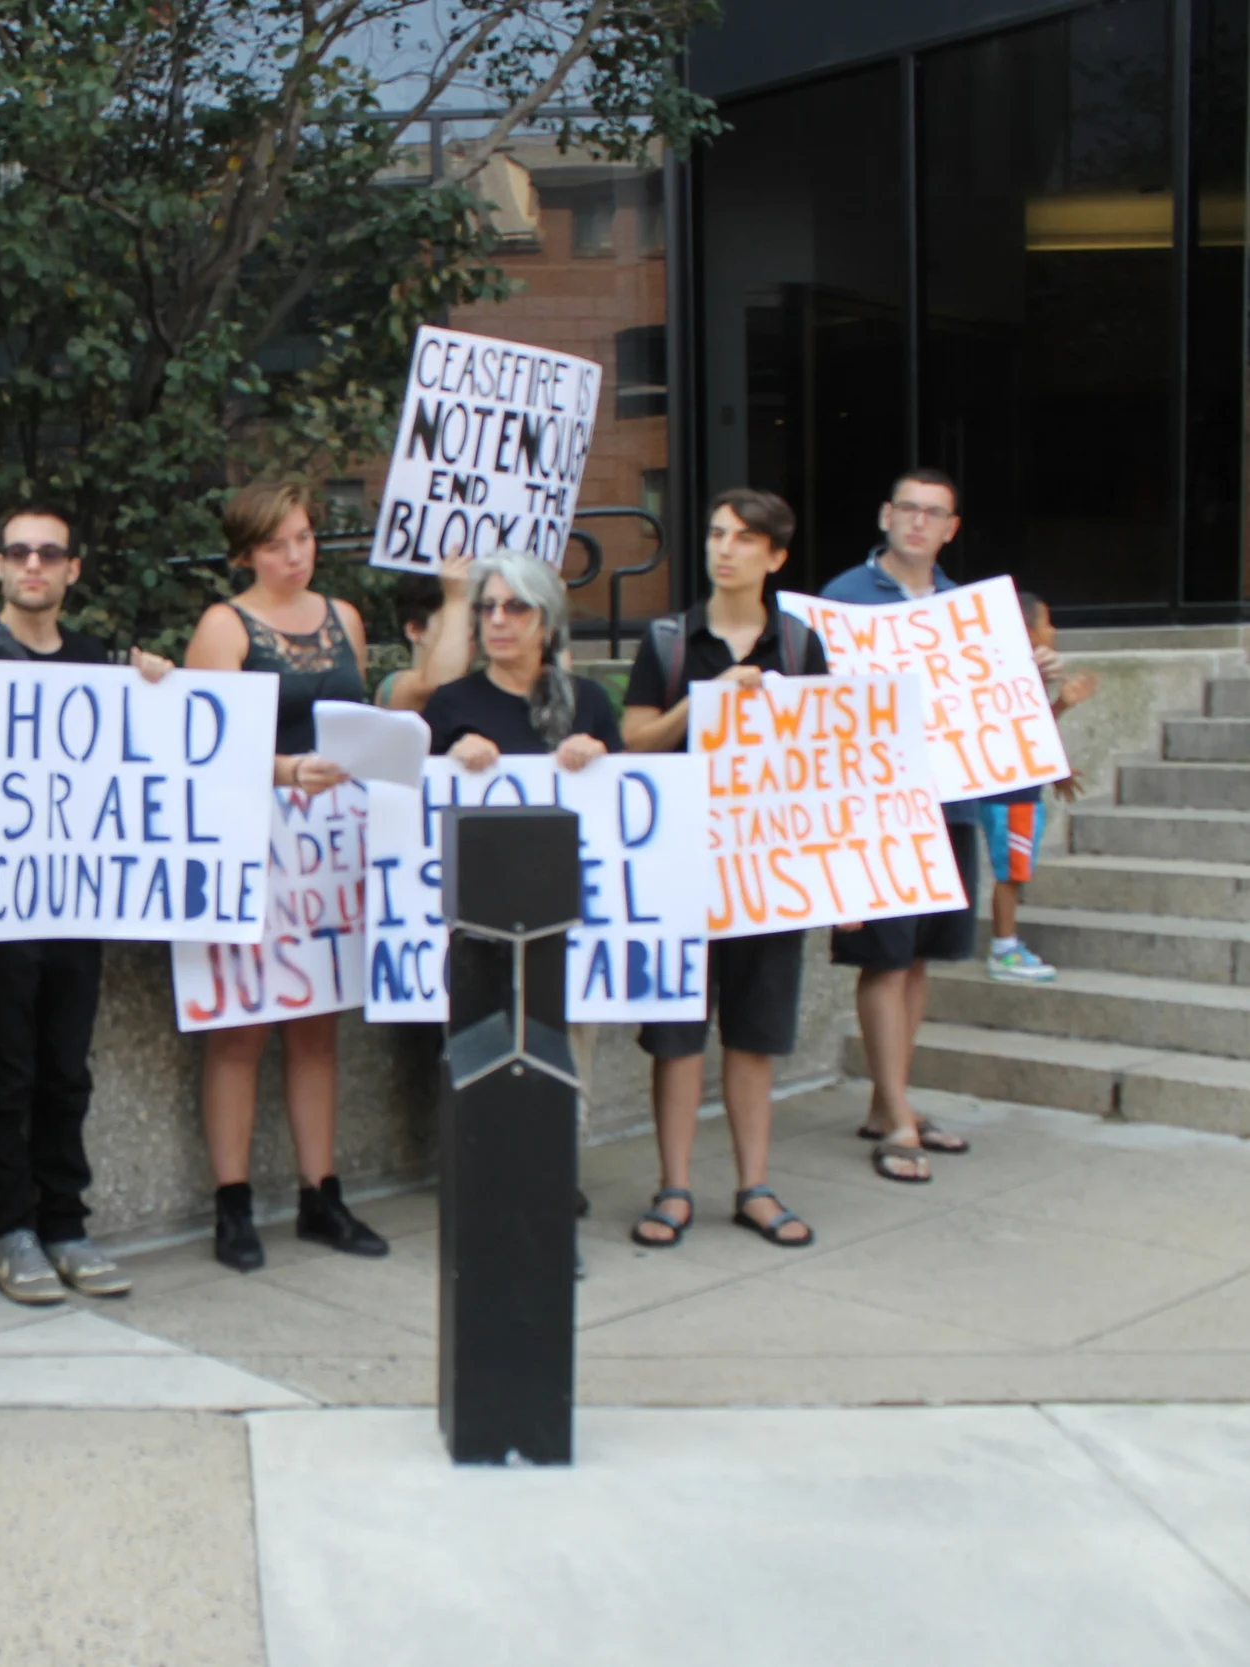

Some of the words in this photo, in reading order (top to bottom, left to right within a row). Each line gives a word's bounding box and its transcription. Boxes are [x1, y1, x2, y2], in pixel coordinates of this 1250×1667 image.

[416, 338, 569, 412] CEASEFIRE
[578, 366, 594, 415] IS
[407, 397, 494, 468] NOT
[428, 471, 488, 505] END
[525, 483, 569, 517] THE
[6, 682, 227, 766] HOLD
[700, 682, 898, 752] JEWISH
[971, 677, 1040, 722] FOR
[708, 742, 908, 797] LEADERS:
[821, 795, 866, 839] UP
[874, 788, 938, 832] FOR
[708, 833, 953, 933] JUSTICE
